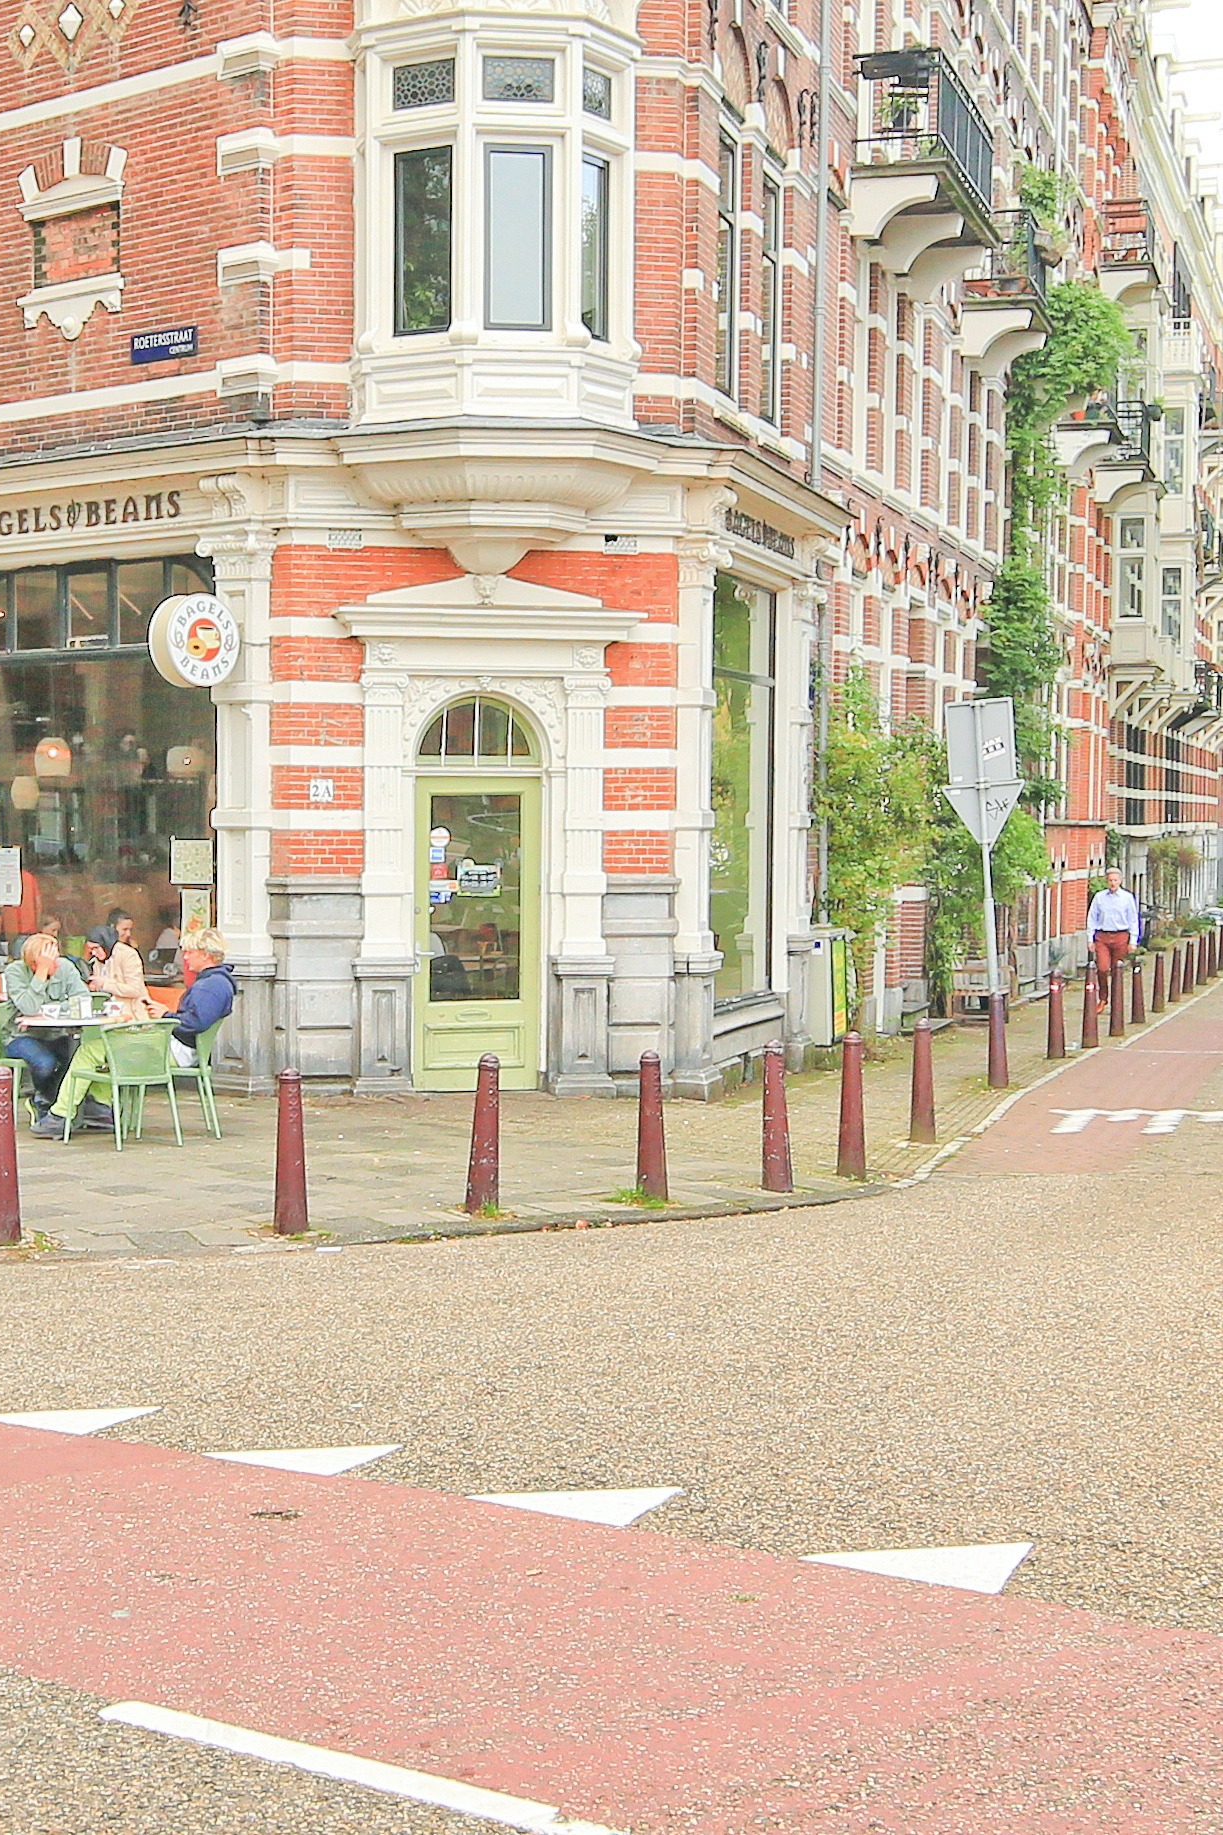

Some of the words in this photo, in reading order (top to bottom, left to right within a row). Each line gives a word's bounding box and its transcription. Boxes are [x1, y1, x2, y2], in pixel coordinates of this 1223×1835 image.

[133, 328, 194, 351] ROETERSSTRAAT
[84, 490, 181, 527] BEANS
[177, 600, 232, 630] BAGELS
[180, 656, 230, 680] BEANS
[311, 784, 332, 798] 2A
